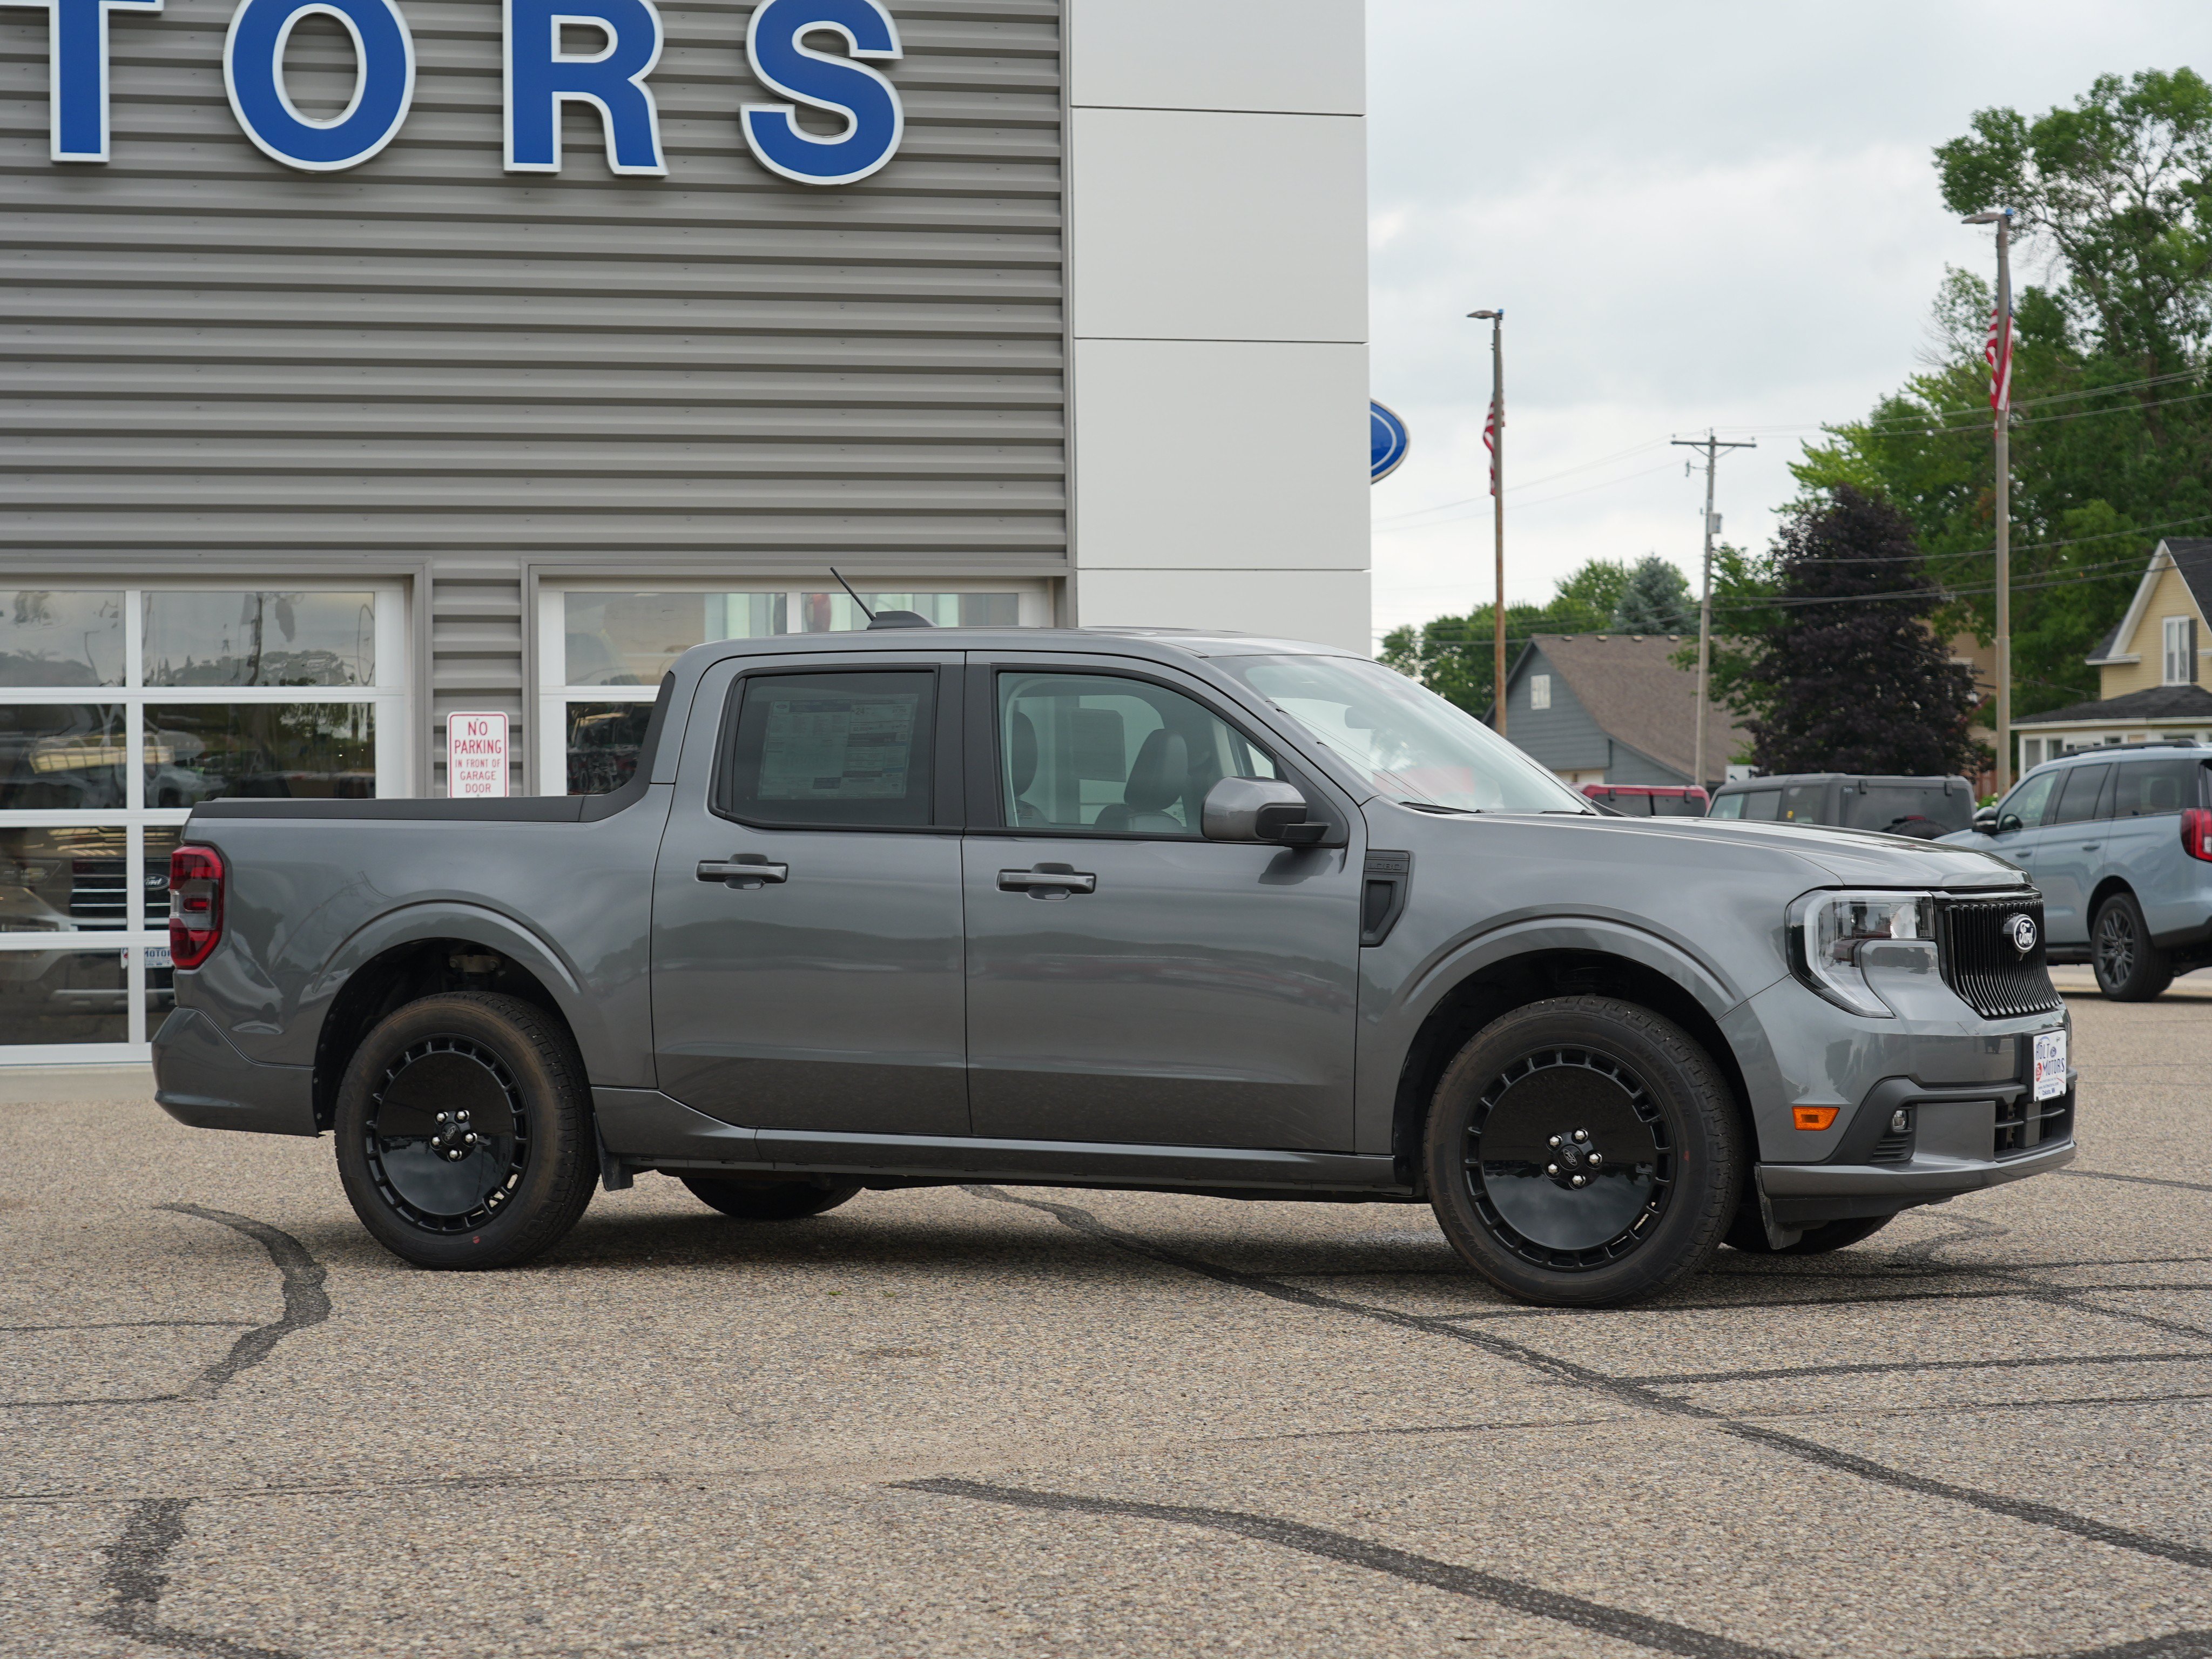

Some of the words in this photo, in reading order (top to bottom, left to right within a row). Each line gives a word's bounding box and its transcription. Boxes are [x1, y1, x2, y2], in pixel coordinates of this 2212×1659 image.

[468, 721, 488, 736] NO
[455, 739, 501, 753] PARKING
[455, 759, 462, 767] IN
[466, 759, 489, 767] FRONT
[492, 758, 501, 767] OF
[460, 771, 496, 780] GARAGE
[466, 784, 491, 793] DOOR
[145, 876, 162, 886] Ford
[2018, 922, 2034, 944] Ford
[2036, 1043, 2050, 1060] HOLT
[2042, 1058, 2065, 1076] MOTORS
